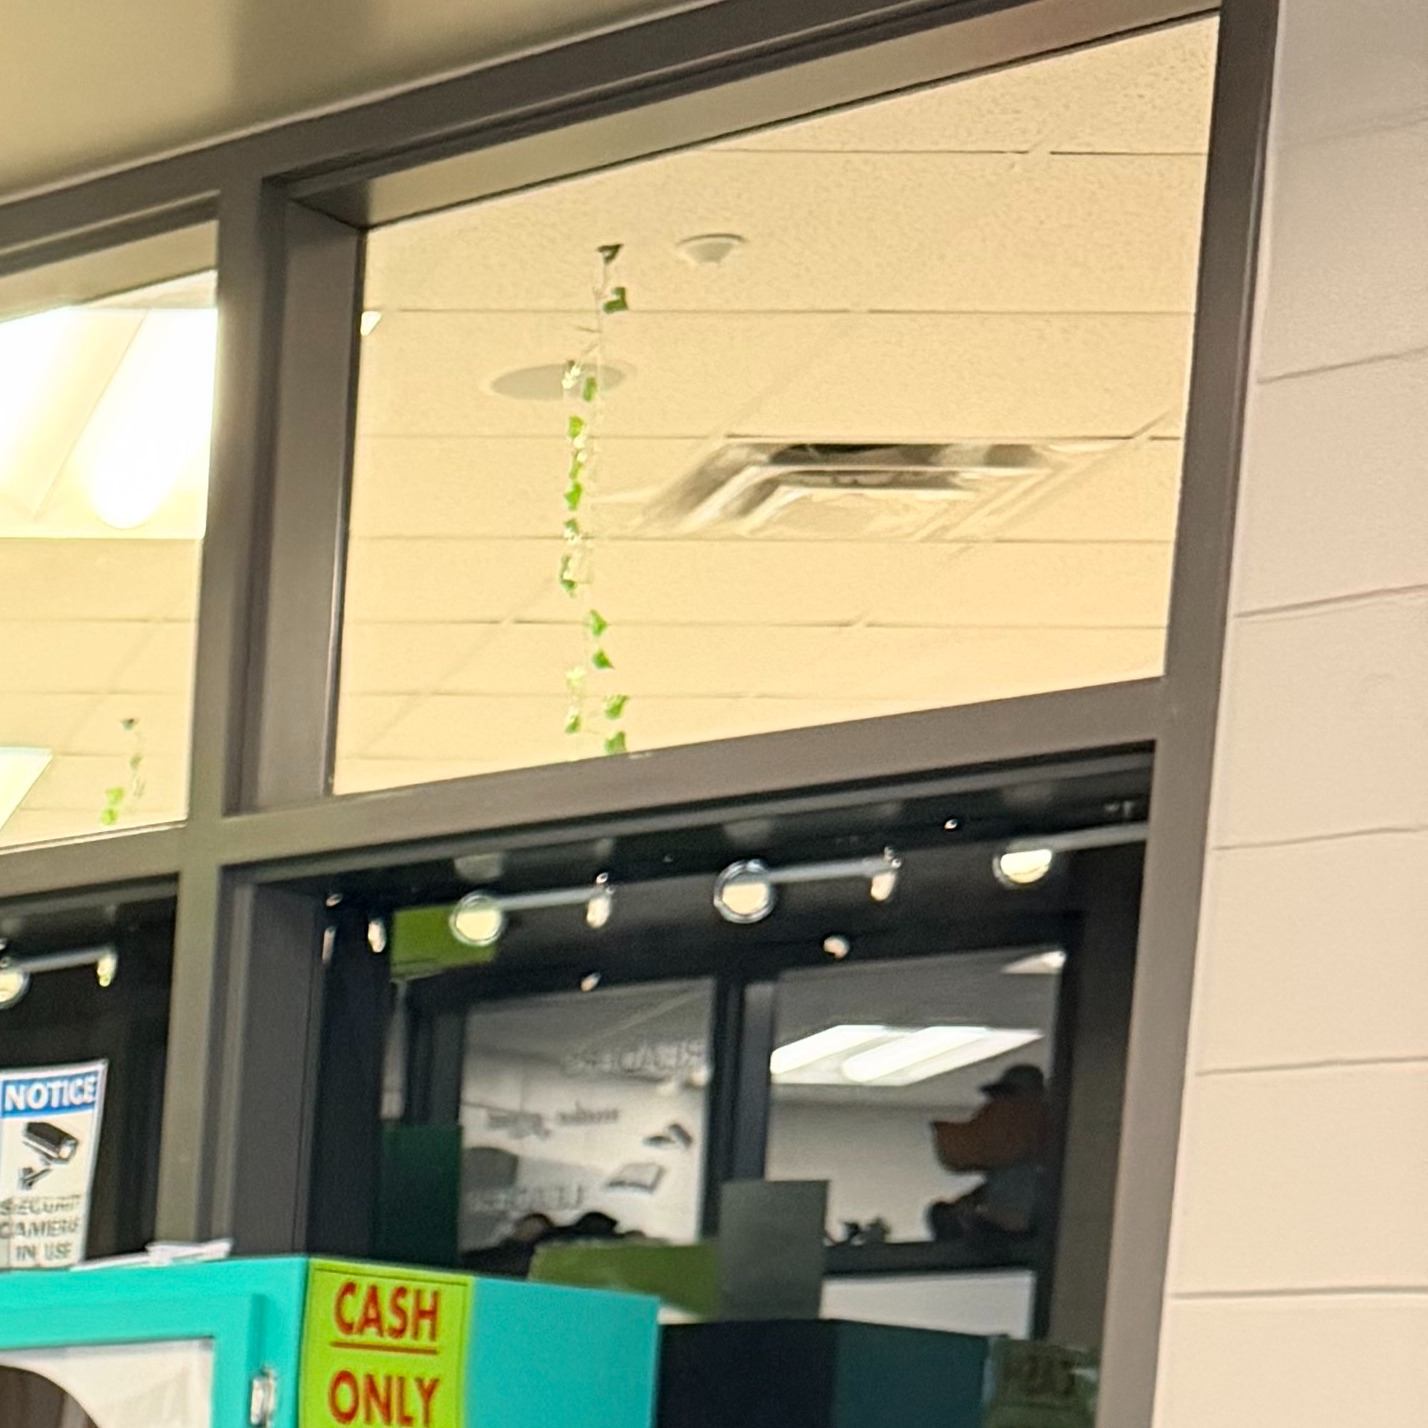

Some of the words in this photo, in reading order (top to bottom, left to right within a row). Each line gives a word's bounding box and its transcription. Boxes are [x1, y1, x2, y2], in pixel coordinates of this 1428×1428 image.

[4, 1076, 97, 1111] NOTICE
[334, 1281, 440, 1341] CASH
[328, 1369, 440, 1428] ONLY
